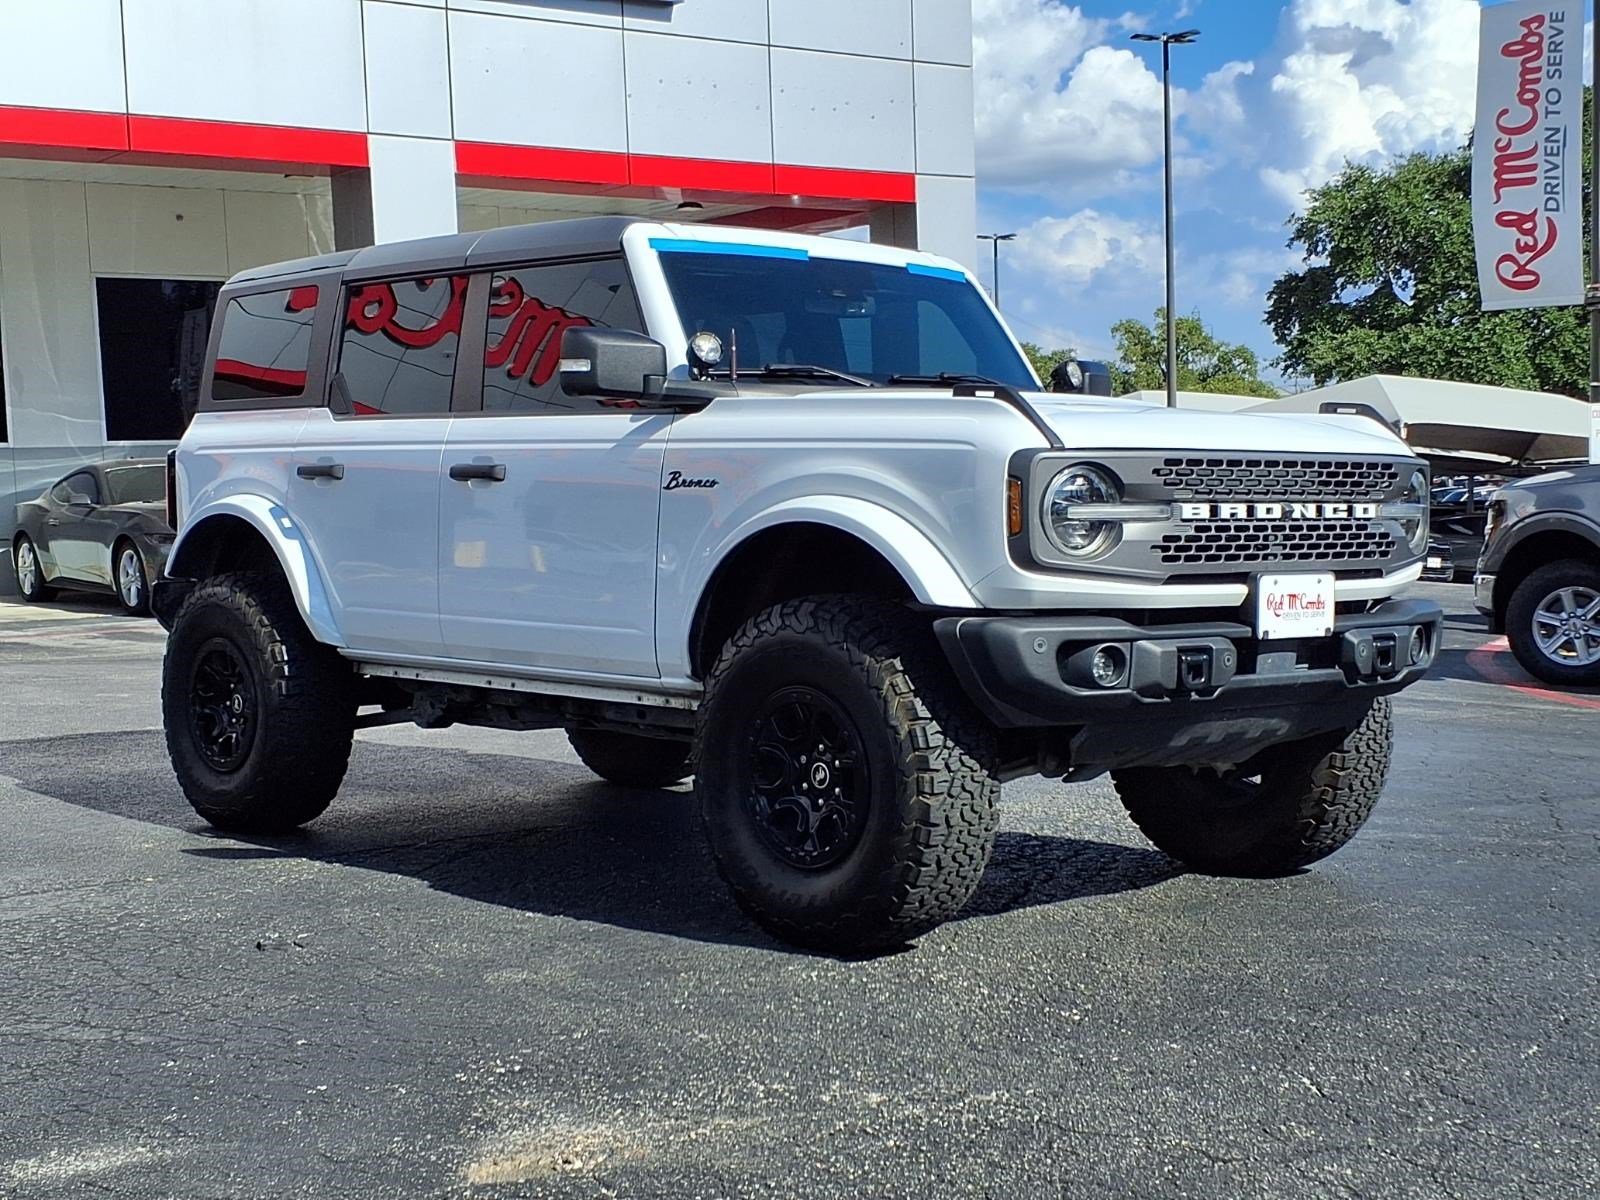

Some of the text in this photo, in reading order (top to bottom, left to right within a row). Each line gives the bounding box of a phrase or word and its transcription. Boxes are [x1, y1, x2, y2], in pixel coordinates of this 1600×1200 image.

[1544, 11, 1565, 213] DRIVEN TO SERVE
[1494, 14, 1557, 291] Red McCombs
[663, 471, 719, 490] Bronco
[1180, 502, 1377, 519] BRONCO
[1267, 592, 1325, 617] Red McCombs
